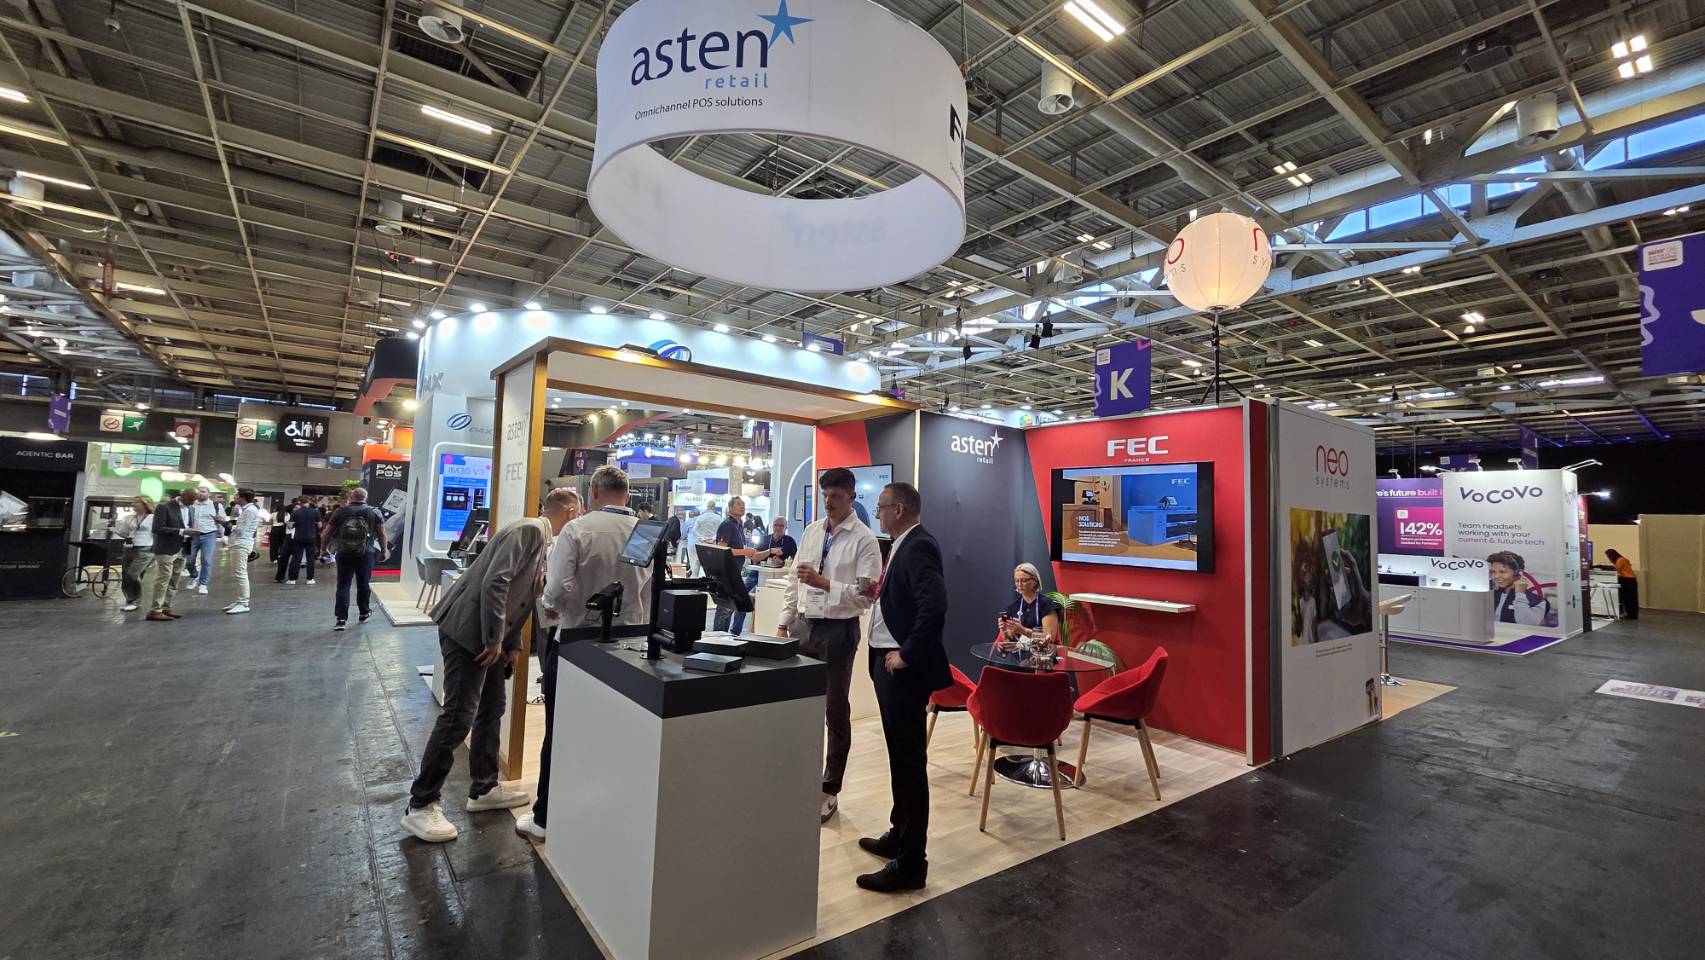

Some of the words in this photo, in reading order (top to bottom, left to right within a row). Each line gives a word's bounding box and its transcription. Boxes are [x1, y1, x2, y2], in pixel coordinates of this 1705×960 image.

[631, 27, 768, 86] asten
[705, 73, 768, 89] retail
[634, 100, 690, 120] Omnichannel
[692, 98, 713, 108] POS
[715, 97, 763, 107] solutions
[1110, 367, 1134, 401] K
[755, 429, 765, 446] M
[951, 435, 994, 457] asten
[1107, 436, 1168, 457] FEC
[16, 450, 54, 458] AGENTIC
[976, 457, 994, 465] retail
[1316, 444, 1349, 477] neo
[376, 463, 402, 471] PAY
[376, 470, 402, 478] POS
[506, 462, 524, 481] FEC
[1316, 476, 1350, 490] systems
[1390, 489, 1416, 497] future
[1417, 488, 1438, 496] built
[1460, 486, 1543, 504] VoCoVo
[1400, 522, 1442, 535] 142%
[1482, 522, 1522, 530] headsets
[1458, 530, 1489, 538] working
[1431, 558, 1484, 570] VoCoVo
